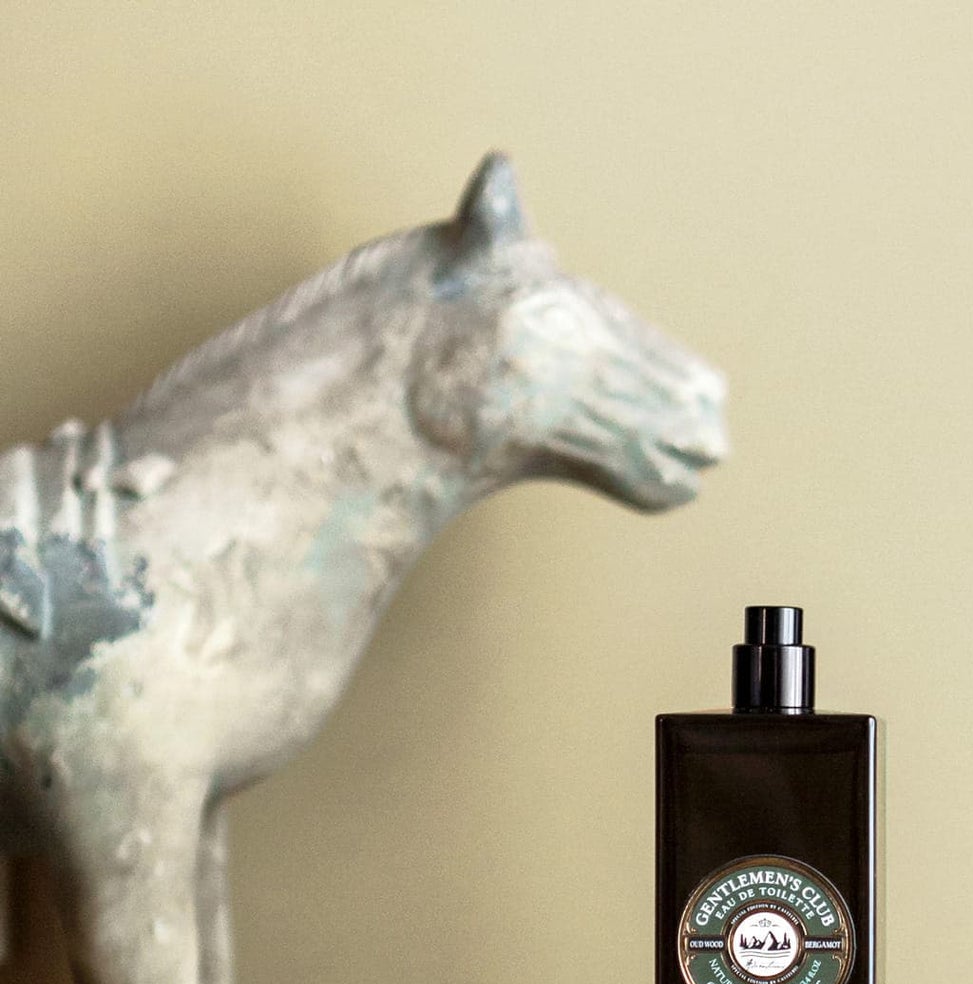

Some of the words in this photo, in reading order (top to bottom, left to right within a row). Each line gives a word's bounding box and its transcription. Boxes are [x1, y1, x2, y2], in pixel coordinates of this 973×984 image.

[696, 871, 802, 926] GENTLEMEN'S
[802, 887, 835, 926] CLUB
[715, 897, 736, 920] EAU
[740, 889, 755, 900] DE
[759, 887, 815, 920] TOILETTE
[805, 940, 841, 948] BERGAMOT
